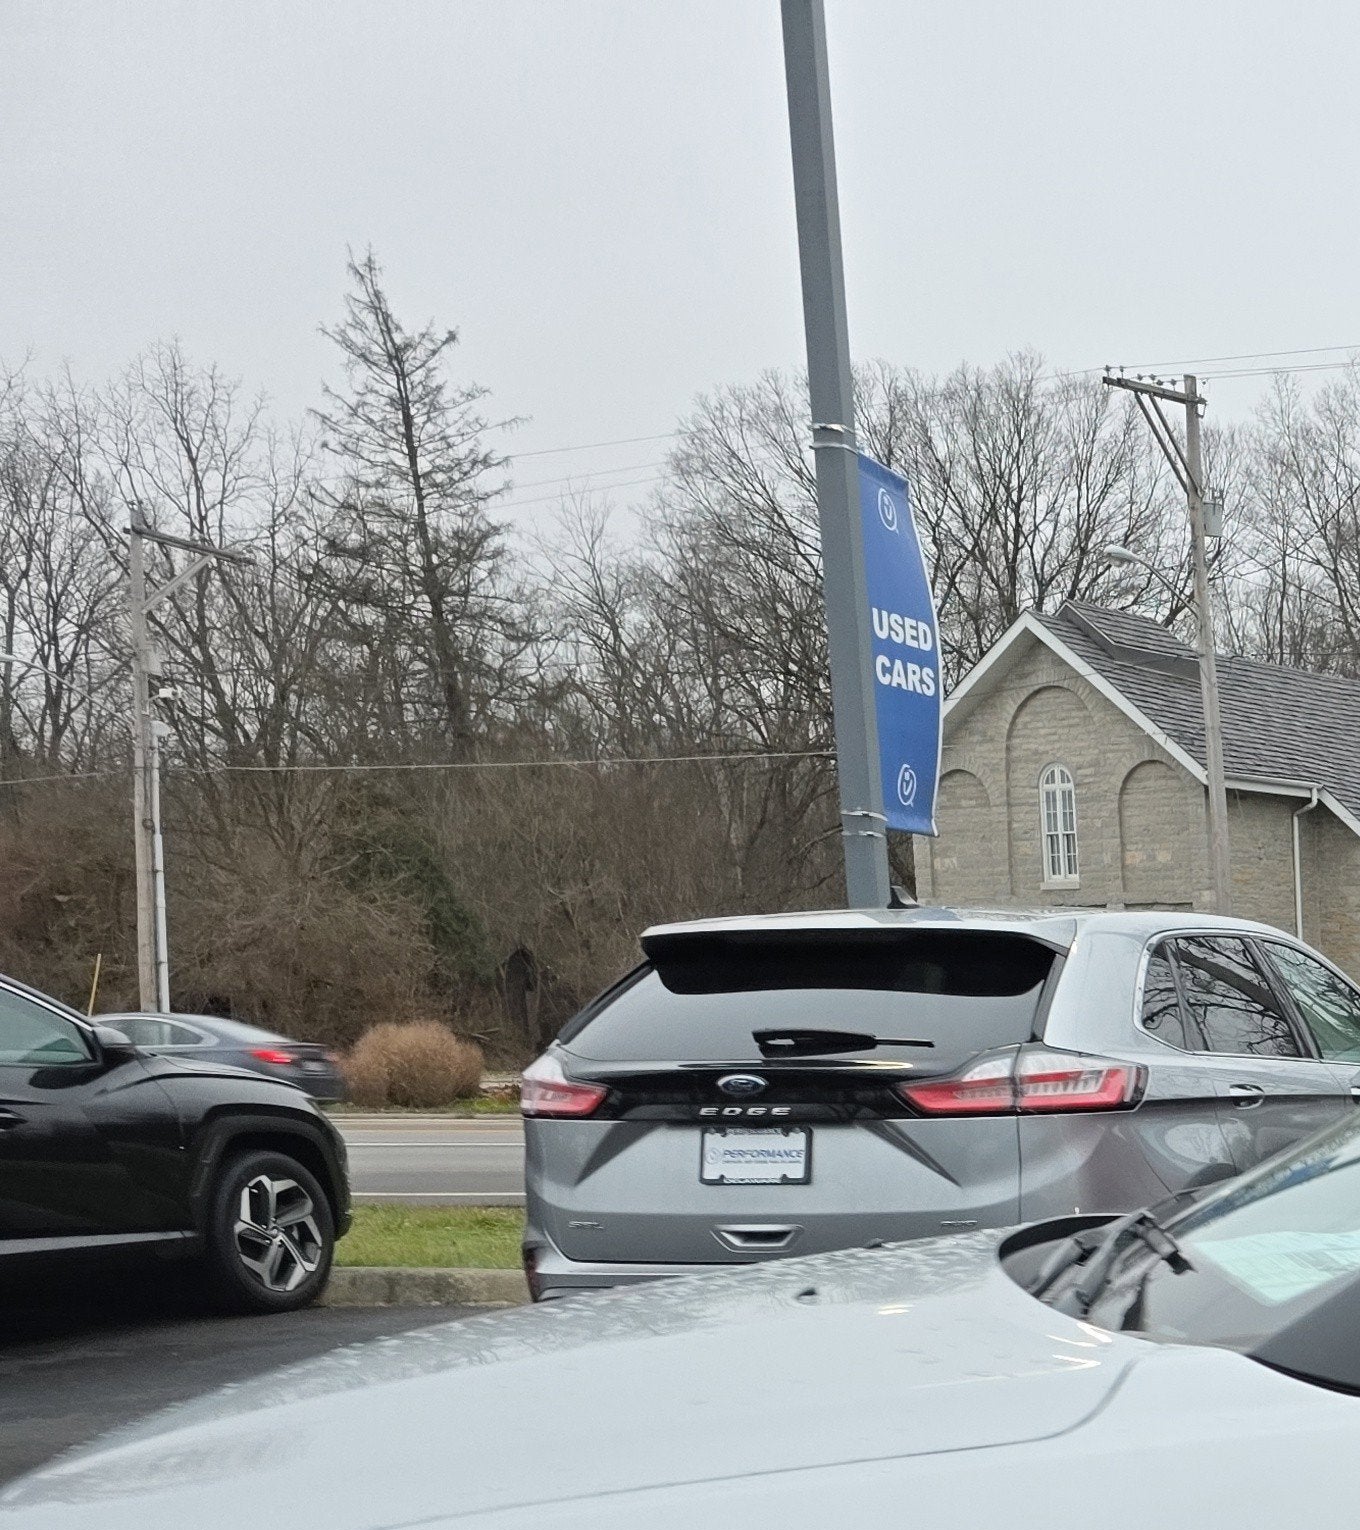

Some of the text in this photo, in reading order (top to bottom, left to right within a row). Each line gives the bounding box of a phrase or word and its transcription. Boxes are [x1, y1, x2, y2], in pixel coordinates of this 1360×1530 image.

[873, 607, 932, 651] USED
[876, 655, 935, 697] CARS
[700, 1107, 791, 1115] EDGE
[722, 1149, 805, 1158] PERFORMANCE
